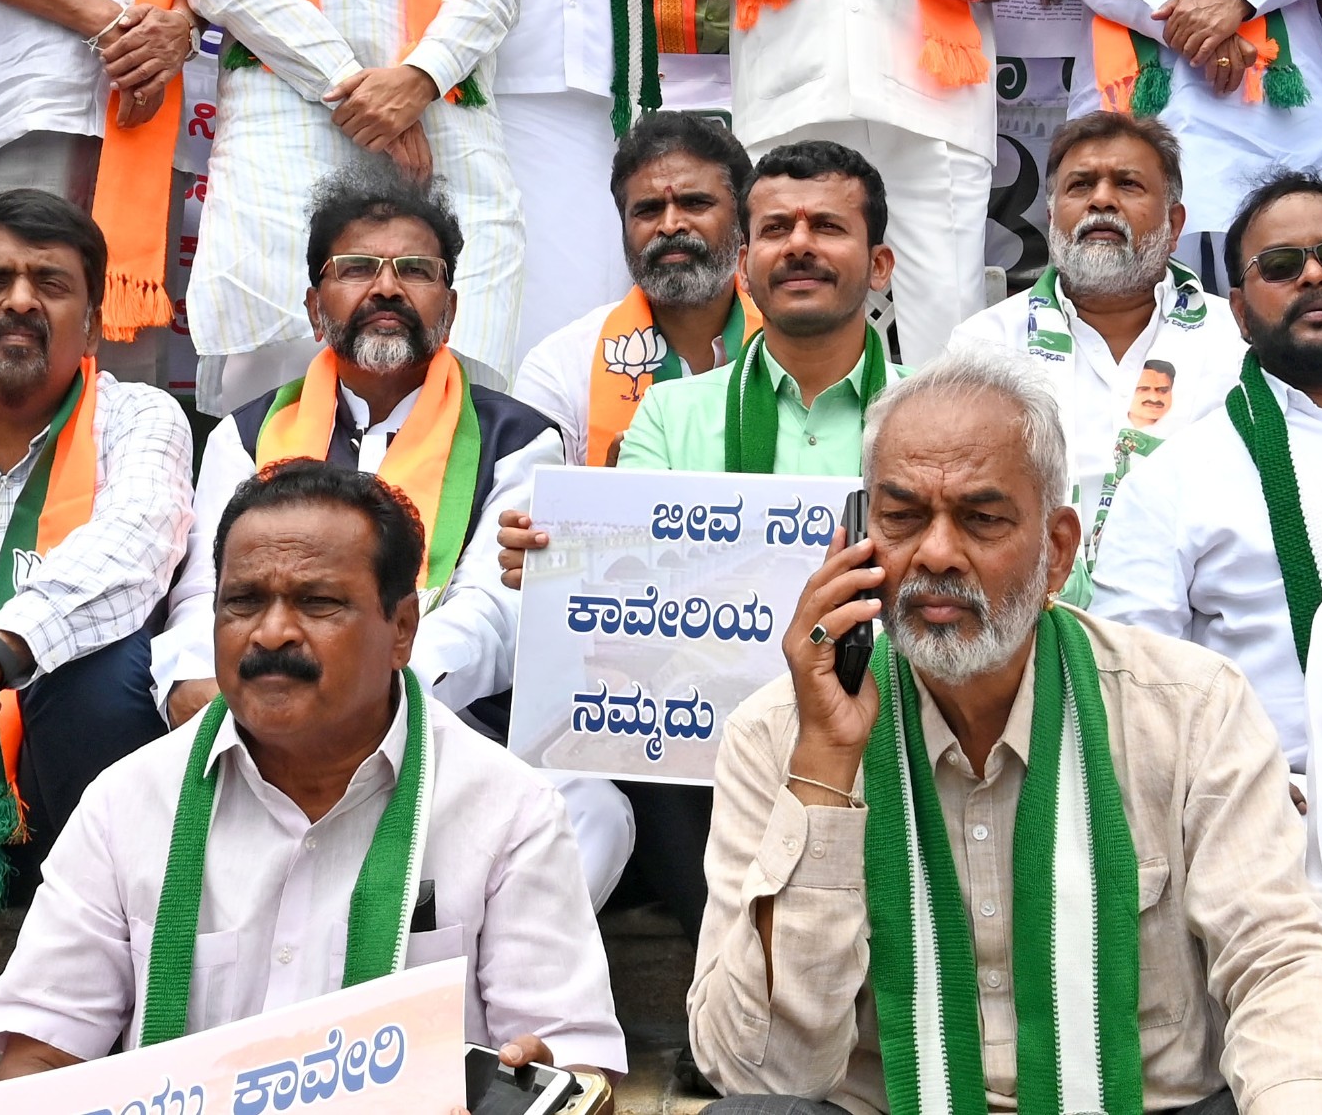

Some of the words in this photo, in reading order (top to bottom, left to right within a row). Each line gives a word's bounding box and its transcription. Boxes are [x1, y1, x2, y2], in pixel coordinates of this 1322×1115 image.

[651, 493, 744, 543] ಜೀವ
[765, 496, 835, 547] ನದಿ
[567, 585, 773, 643] ಕಾವೇರಿಯ
[572, 680, 714, 761] ನಮ್ಮದು
[231, 1024, 406, 1115] ಕಾವೇರಿ
